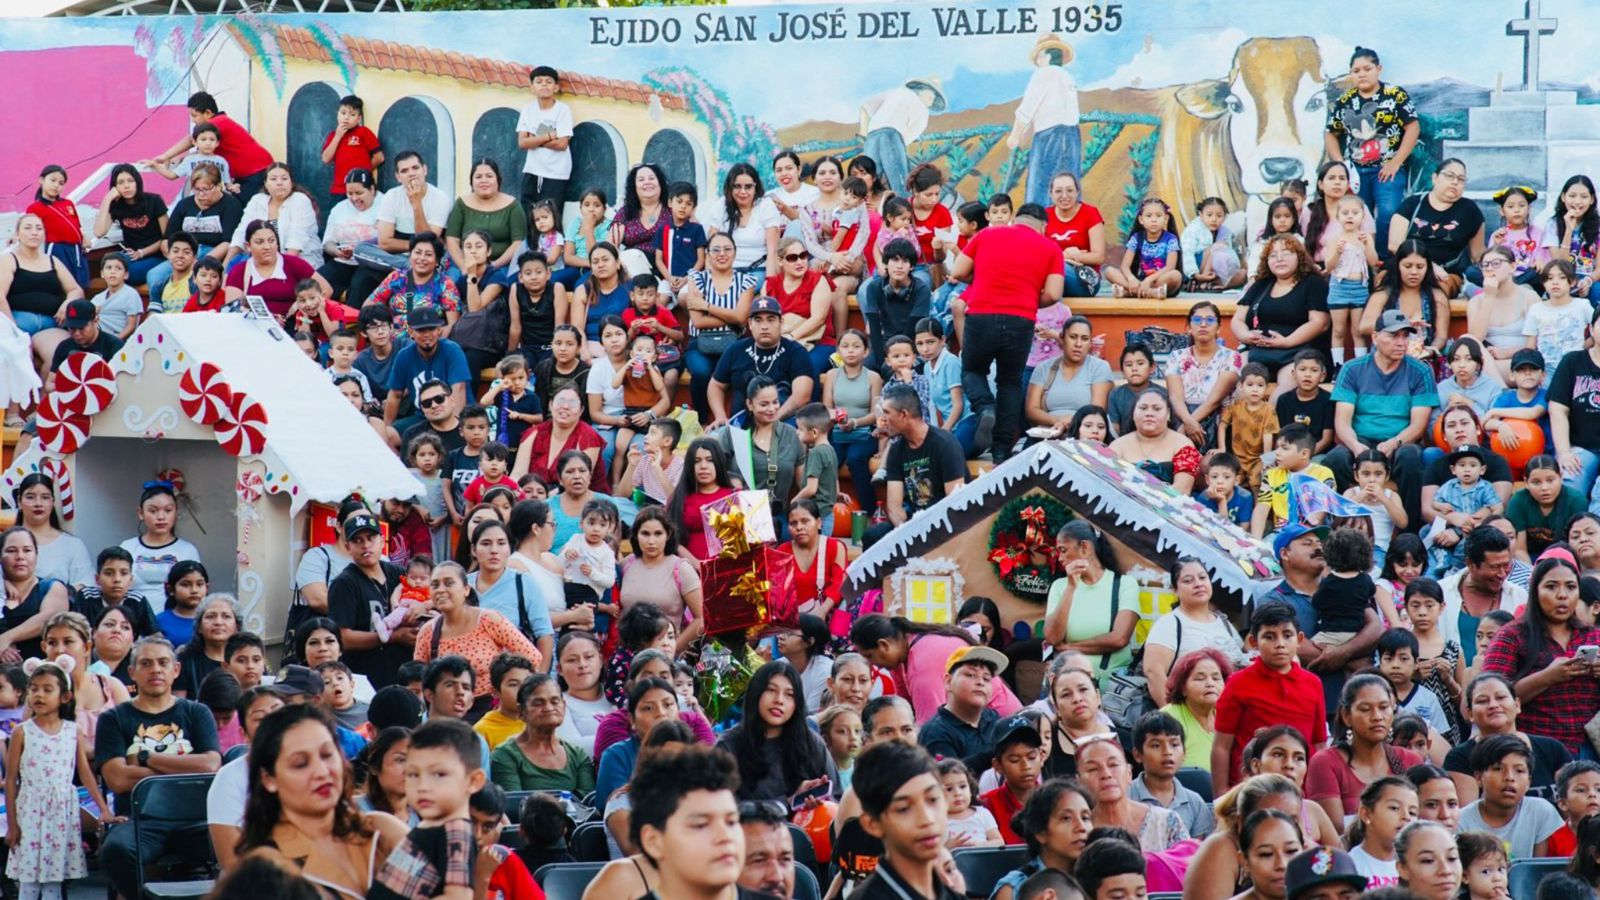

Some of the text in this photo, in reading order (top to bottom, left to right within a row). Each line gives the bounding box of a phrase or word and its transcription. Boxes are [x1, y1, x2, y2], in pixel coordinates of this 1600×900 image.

[589, 4, 1123, 46] EJIDO SAN JOSÉ DEL VALLE 1935
